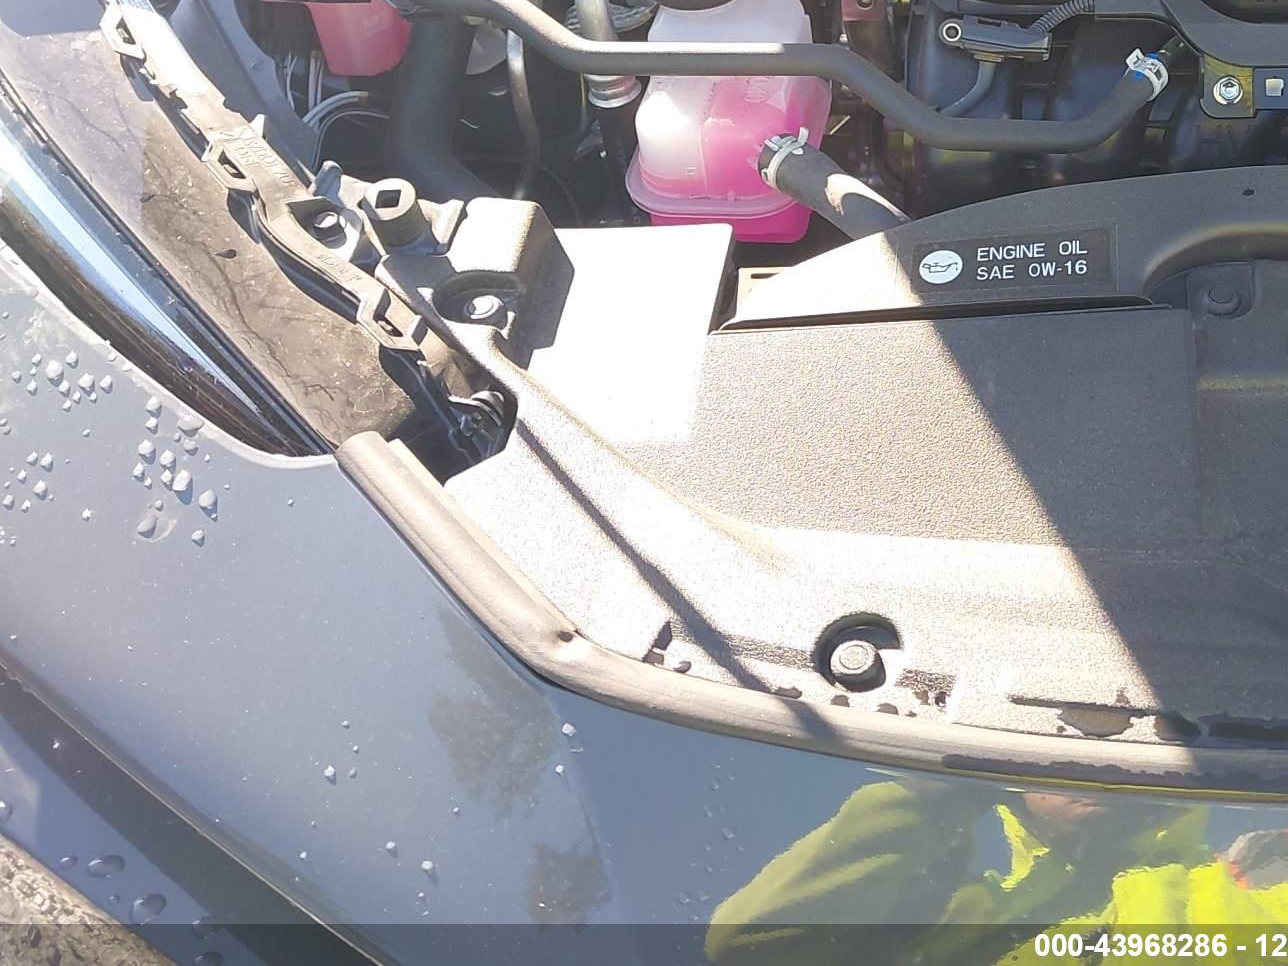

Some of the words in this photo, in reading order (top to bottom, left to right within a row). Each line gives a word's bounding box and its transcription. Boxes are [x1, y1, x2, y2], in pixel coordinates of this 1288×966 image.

[976, 243, 1046, 261] ENGINE
[1058, 240, 1088, 255] OIL
[976, 265, 1015, 281] SAE
[1028, 260, 1088, 278] 0W-16
